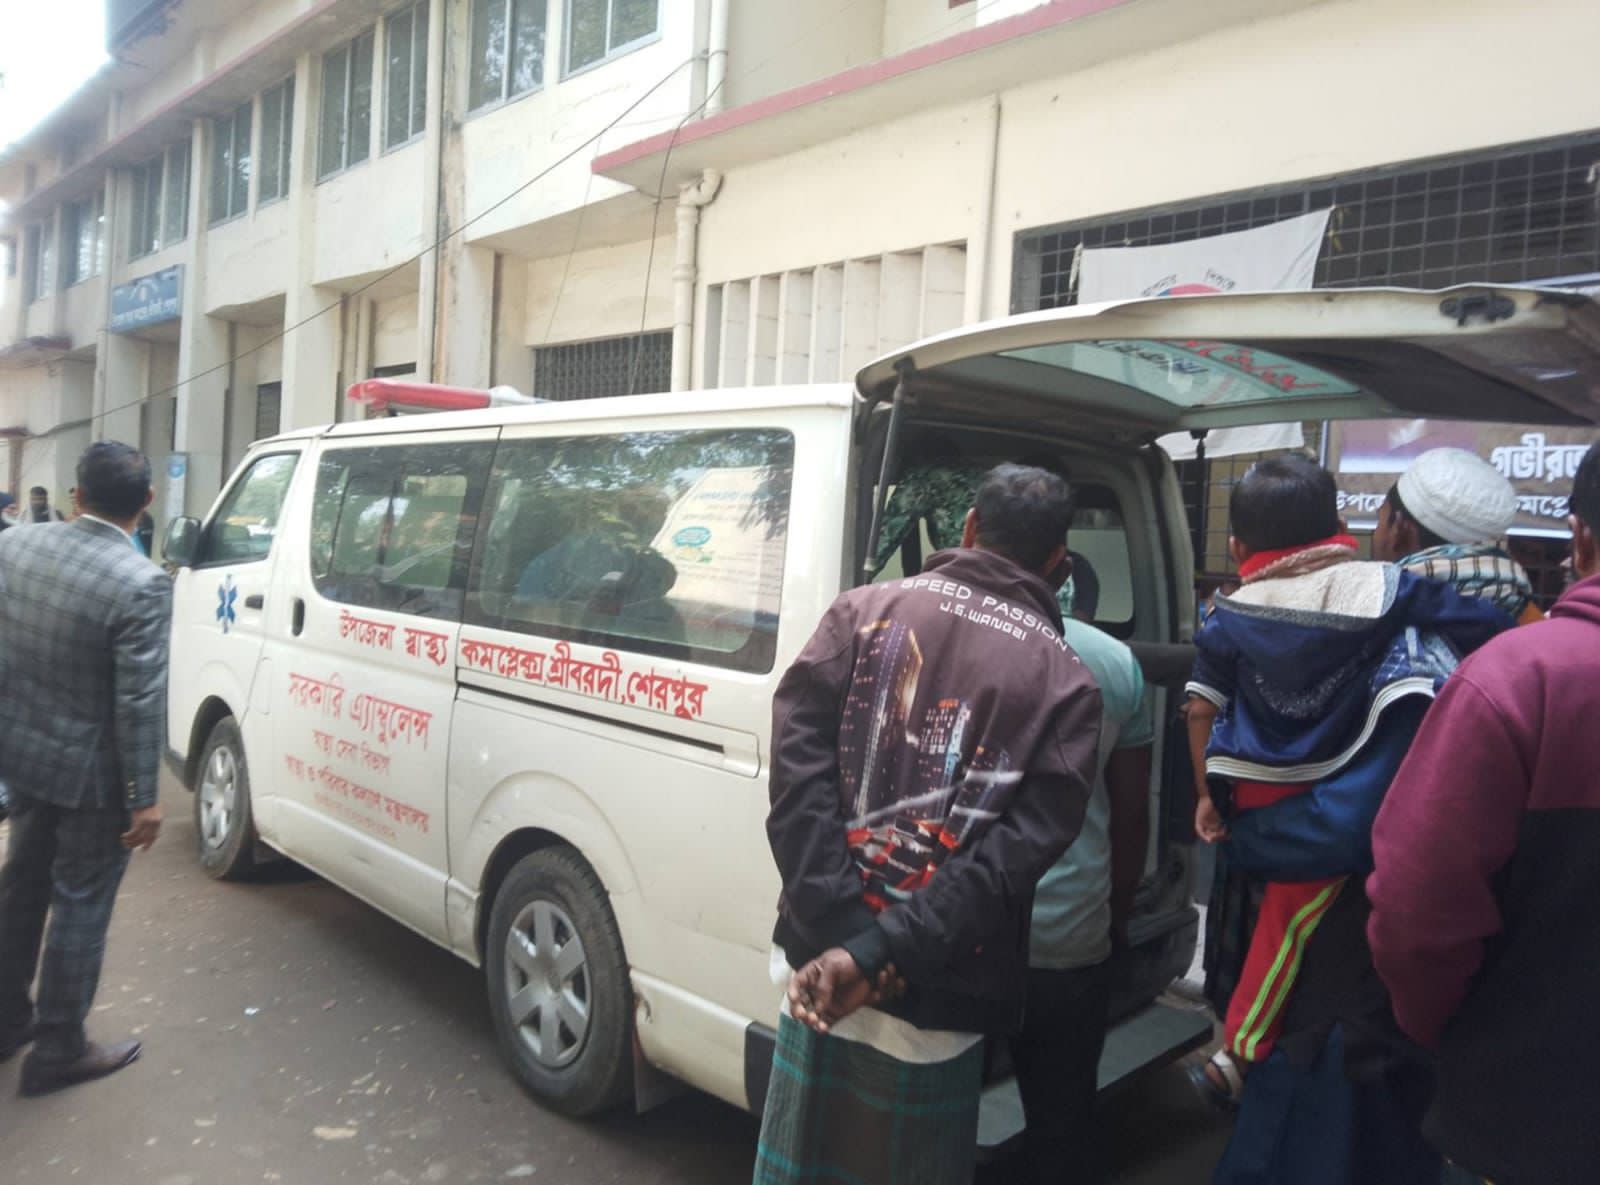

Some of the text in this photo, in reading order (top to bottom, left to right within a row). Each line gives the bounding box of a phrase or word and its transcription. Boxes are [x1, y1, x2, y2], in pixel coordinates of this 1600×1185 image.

[339, 609, 396, 650] উপজেলা
[403, 627, 449, 667] স্বাস্থ্য
[901, 578, 1067, 651] SPEED PASSION
[288, 671, 345, 720] সরকারি
